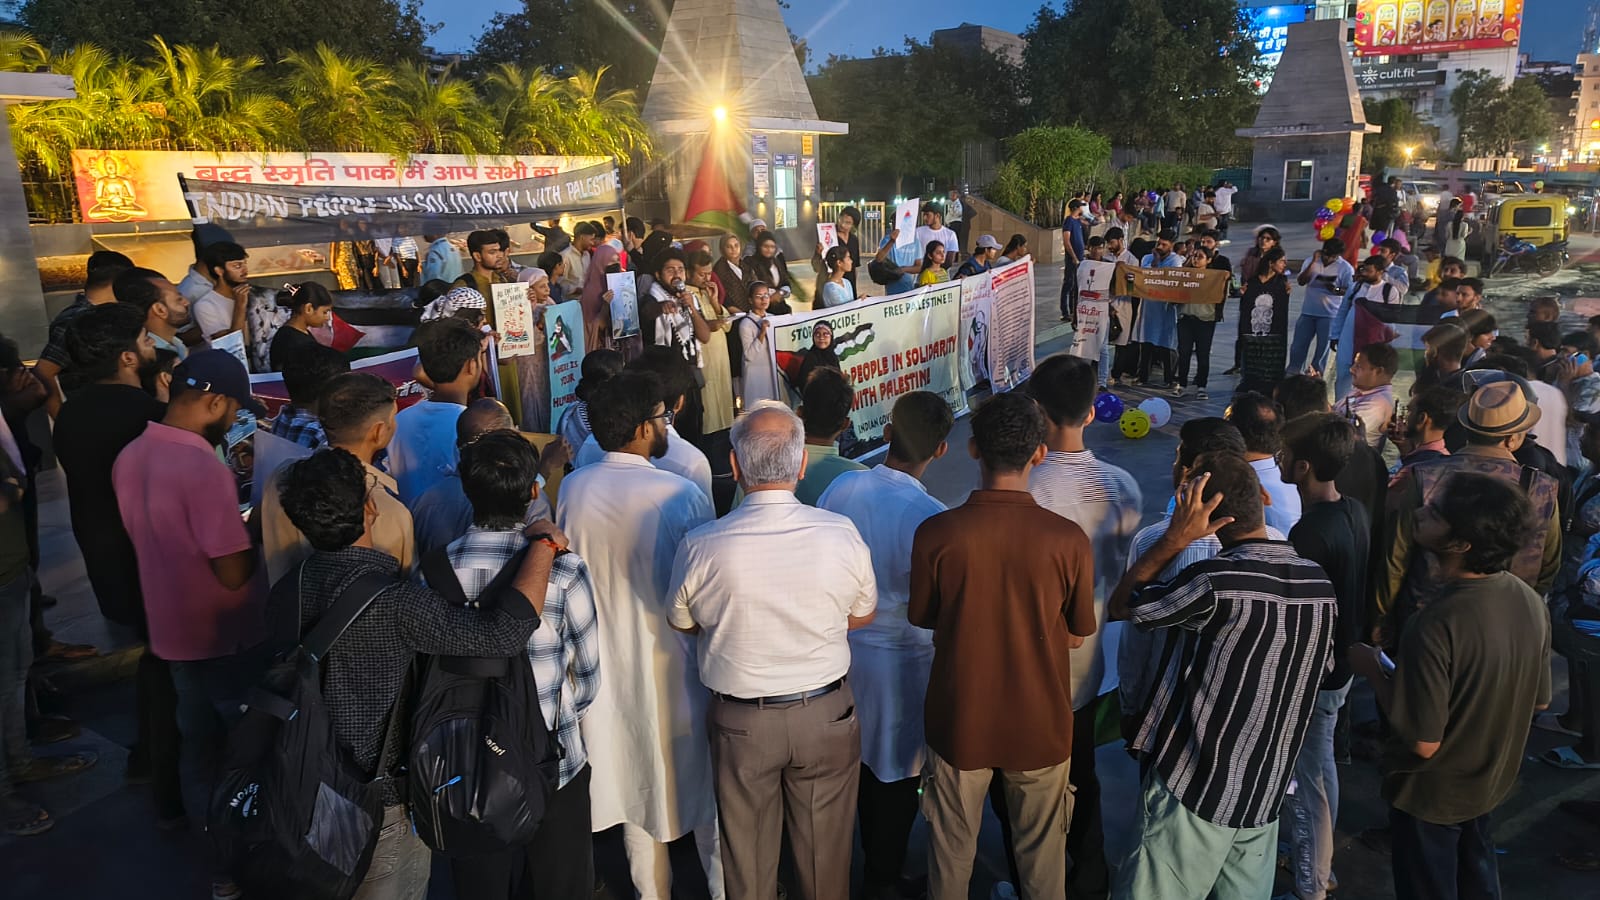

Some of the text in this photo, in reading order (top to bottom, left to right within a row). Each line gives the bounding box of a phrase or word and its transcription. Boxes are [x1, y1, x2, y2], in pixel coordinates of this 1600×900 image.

[1380, 67, 1415, 79] cult.fit
[263, 159, 335, 186] स्मृति
[342, 159, 397, 181] पार्क
[404, 160, 429, 181] में
[433, 166, 481, 181] आप
[485, 160, 528, 181] सभी
[532, 166, 559, 178] का
[185, 168, 621, 225] INDIAN PEOPLE IN SOLIDARITY WITH PALESTINE
[866, 211, 879, 219] OUT
[883, 303, 903, 318] FREE
[851, 354, 889, 385] PEOPLE
[892, 351, 903, 372] IN
[905, 335, 957, 367] SOLIDARITY
[858, 416, 879, 433] INDIAN
